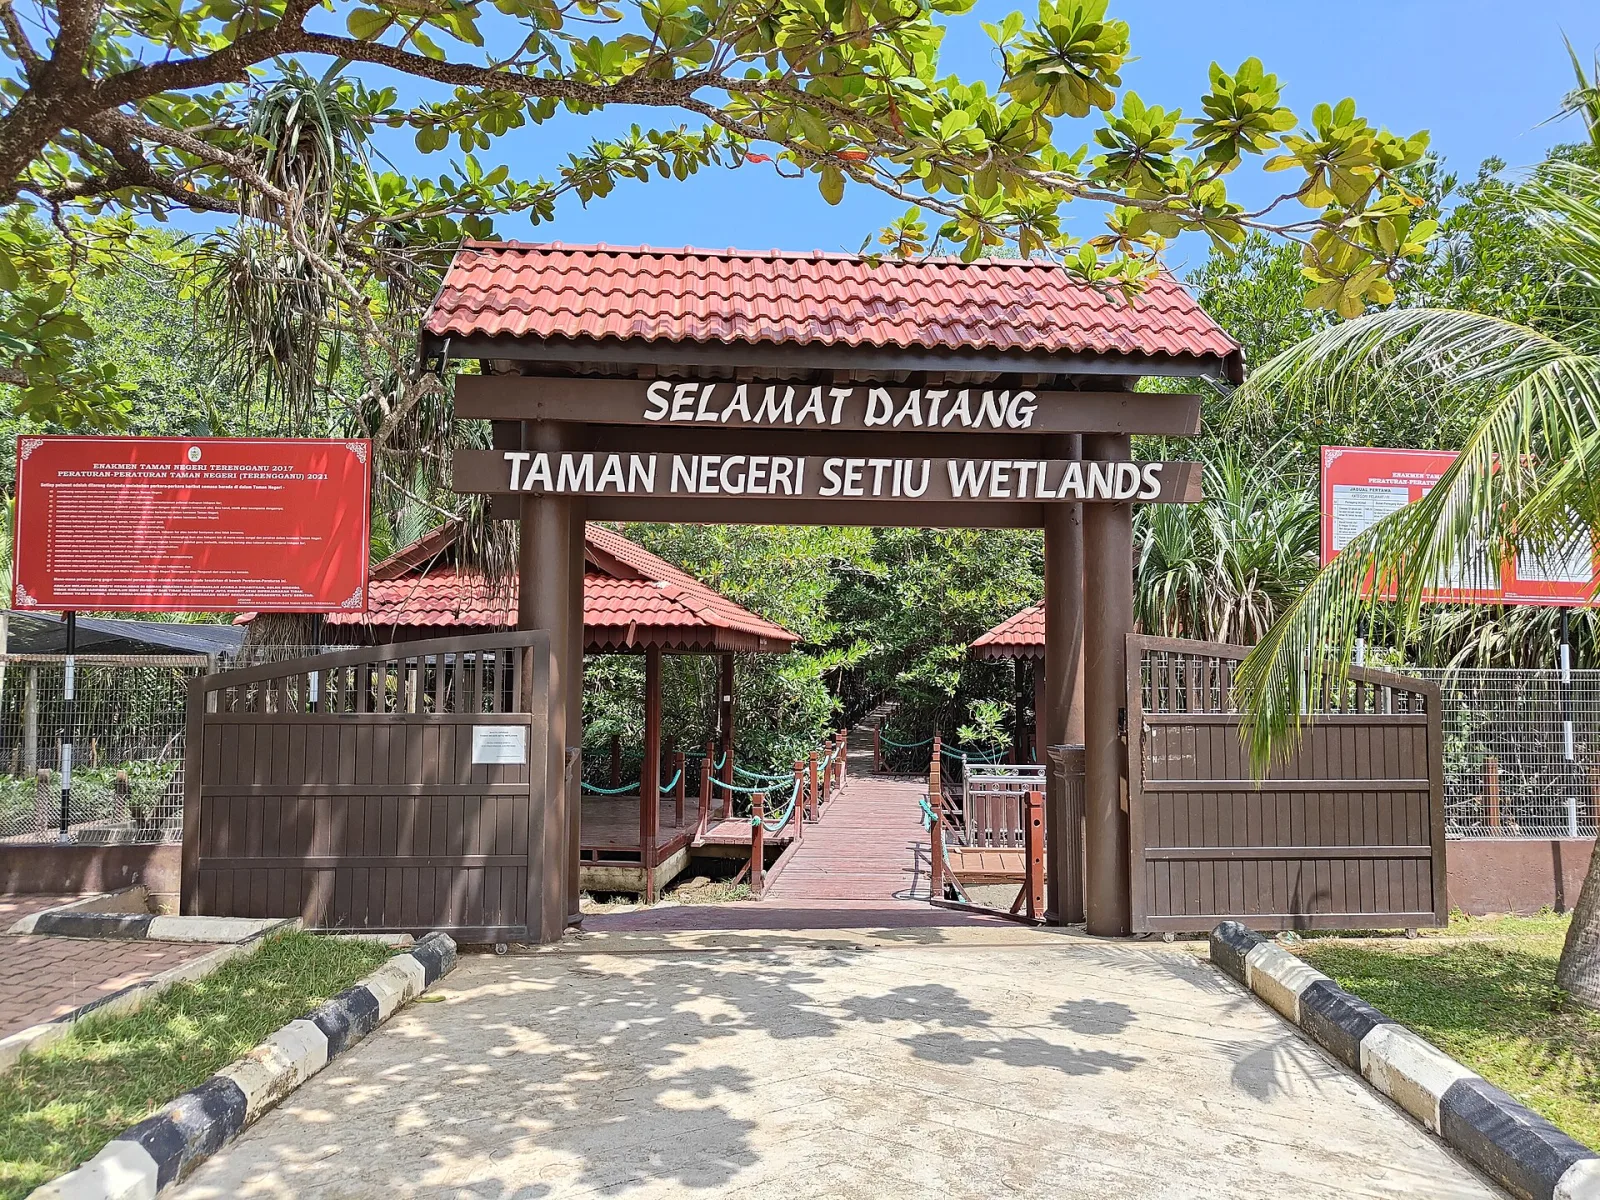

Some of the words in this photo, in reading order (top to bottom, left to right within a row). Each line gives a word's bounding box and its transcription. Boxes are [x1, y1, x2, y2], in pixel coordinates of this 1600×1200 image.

[643, 380, 853, 426] SELAMAT
[863, 386, 1038, 429] DATANG
[239, 473, 305, 481] (TERENGGANU)
[503, 452, 657, 493] TAMAN
[670, 454, 805, 495] NEGERI
[818, 457, 931, 498] SETIU
[946, 460, 1163, 500] WETLANDS
